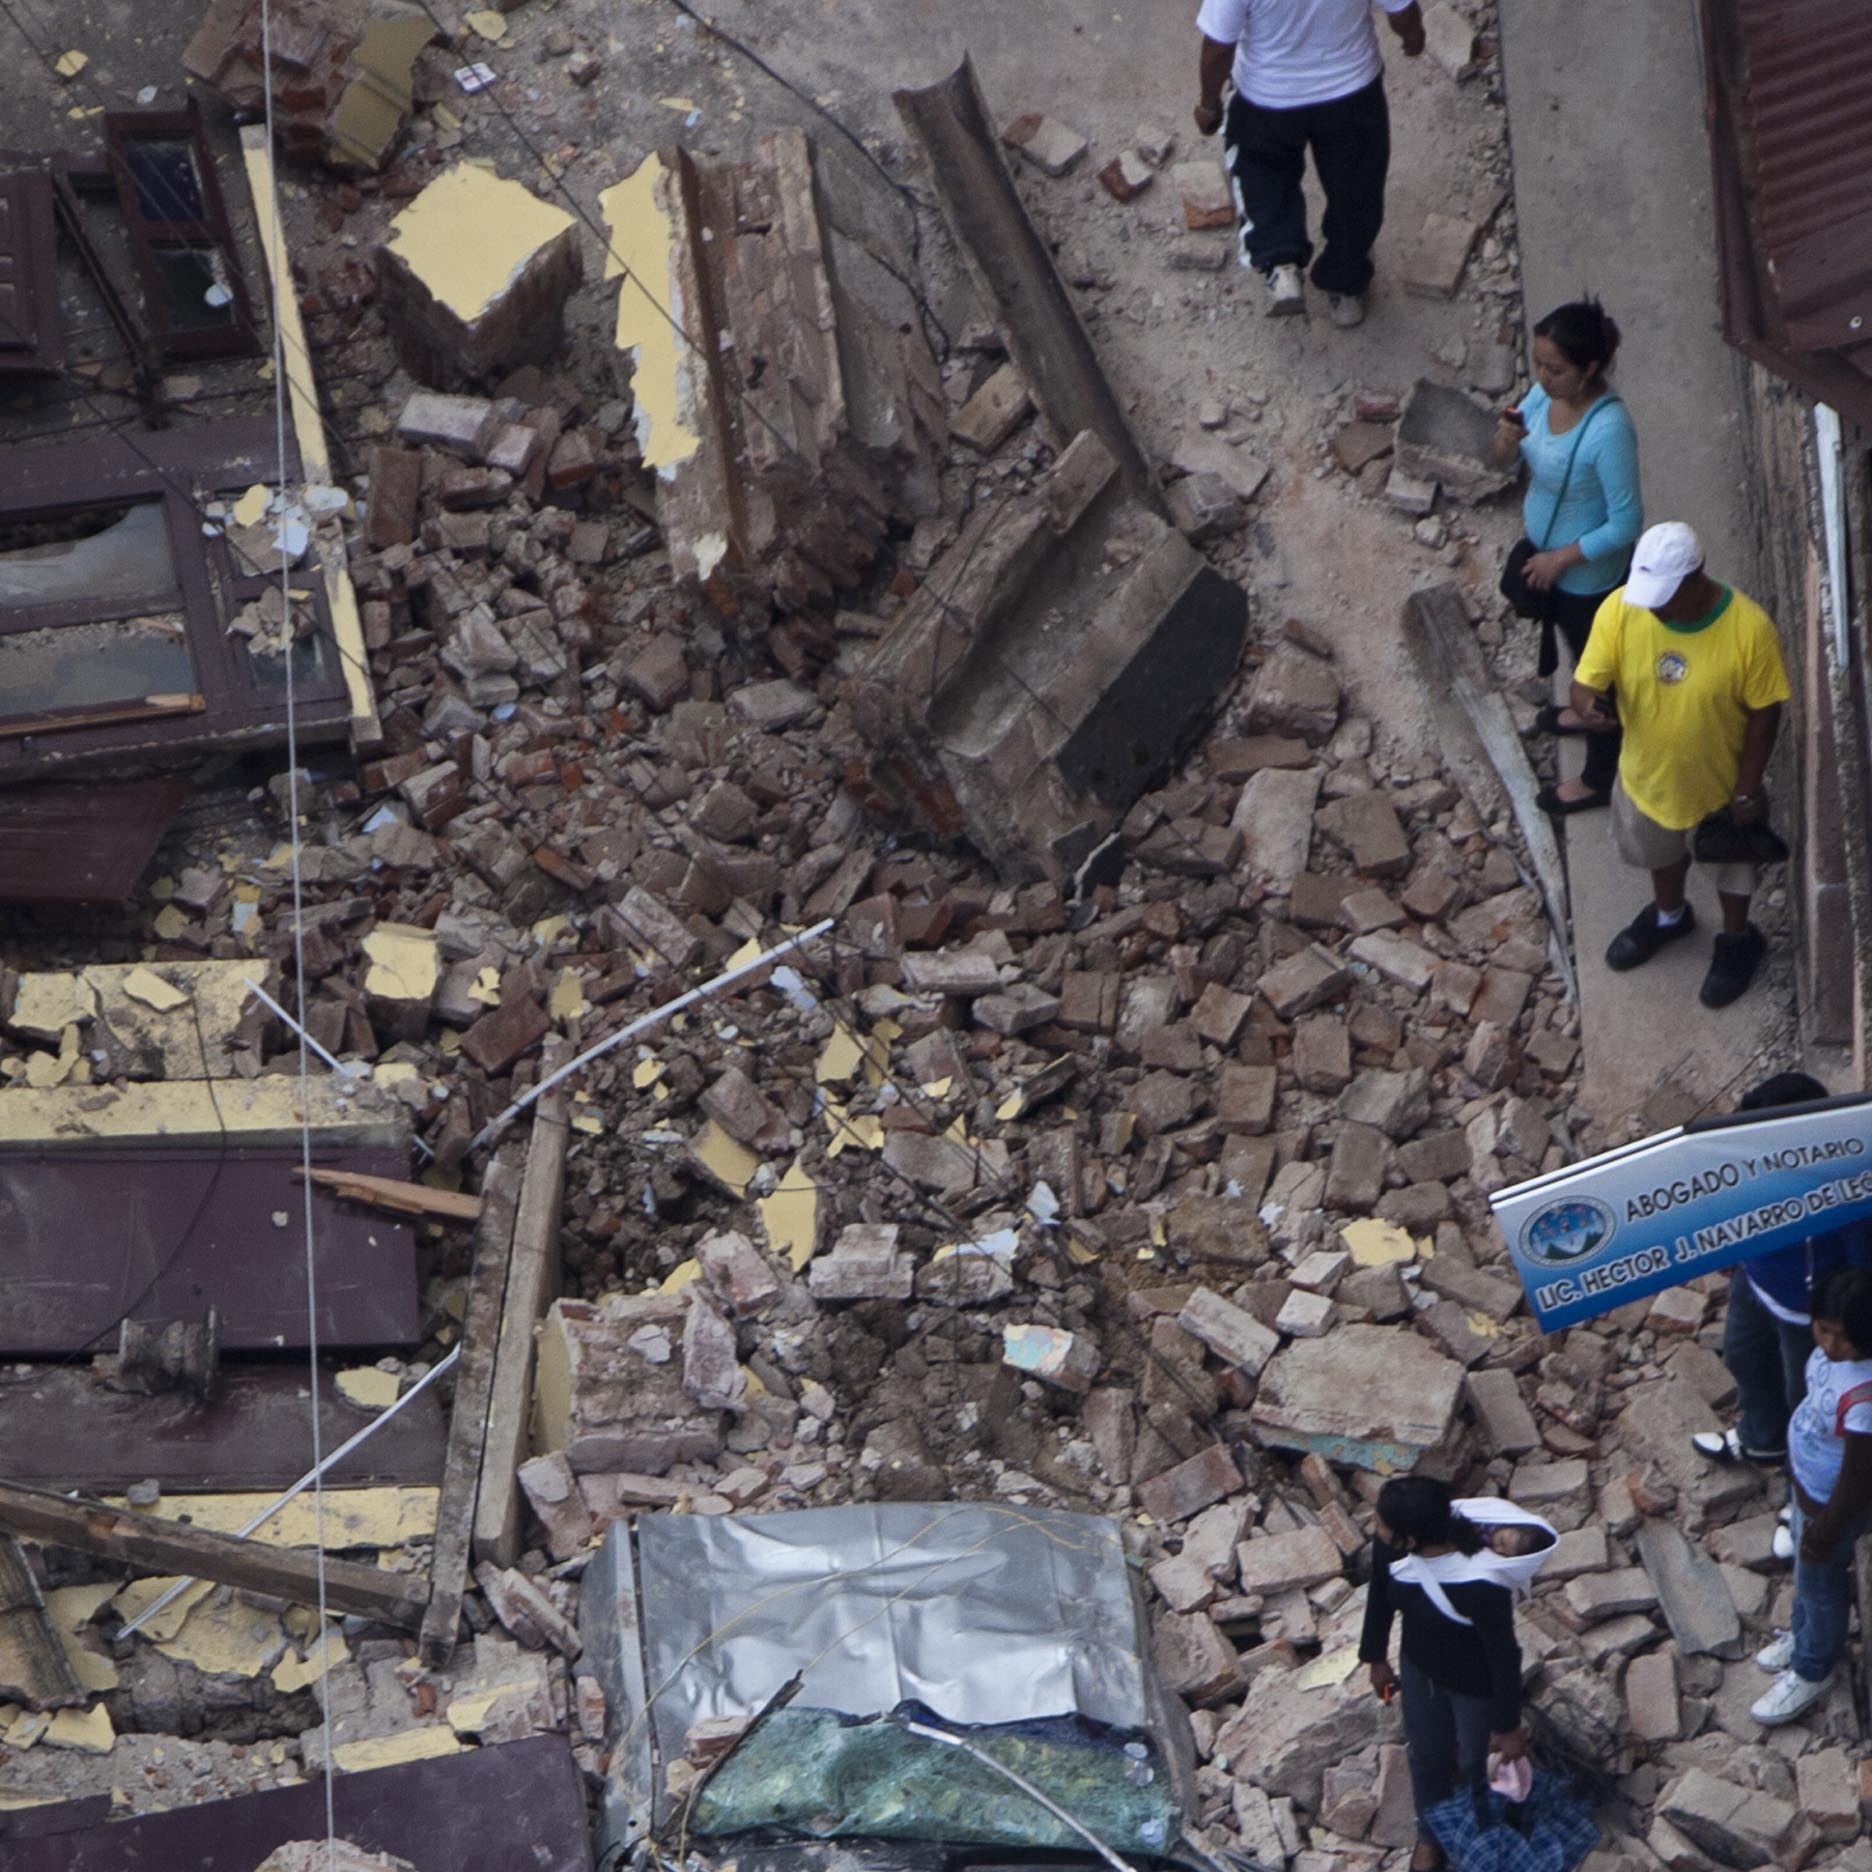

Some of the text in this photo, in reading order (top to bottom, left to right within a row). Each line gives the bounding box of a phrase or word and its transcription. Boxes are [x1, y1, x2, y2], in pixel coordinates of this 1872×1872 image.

[1626, 1137, 1865, 1222] ABOGADO Y NOTARIO
[1536, 1279, 1583, 1312] LIC.
[1581, 1246, 1669, 1295] HECTOR
[1675, 1241, 1697, 1266] J.
[1696, 1197, 1805, 1255] NAVARRO
[1806, 1184, 1836, 1215] DE
